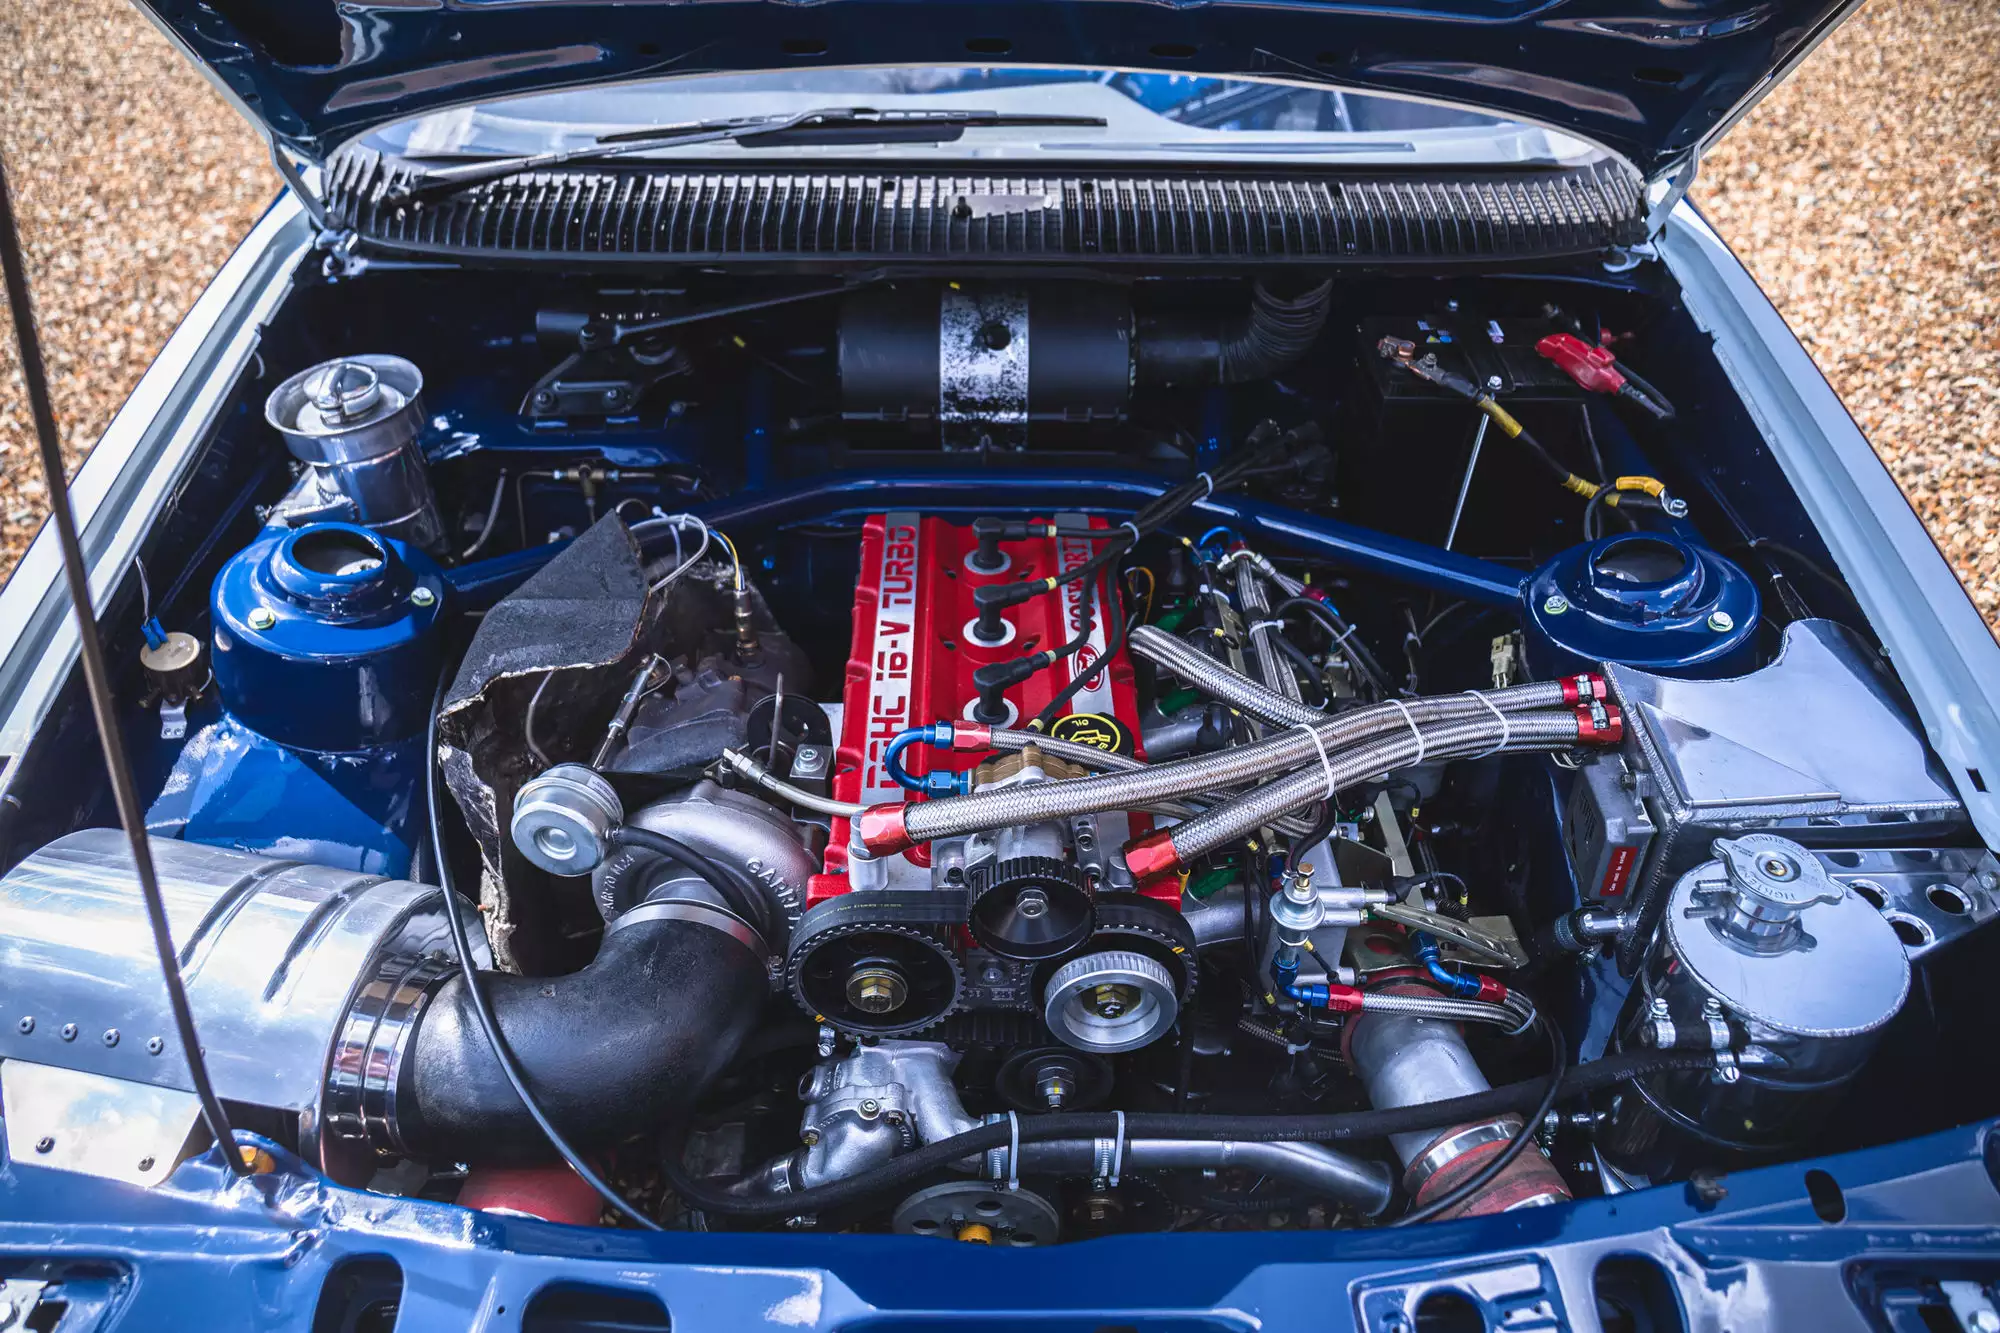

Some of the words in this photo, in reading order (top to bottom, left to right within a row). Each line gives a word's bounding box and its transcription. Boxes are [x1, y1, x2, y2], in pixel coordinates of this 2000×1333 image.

[882, 525, 916, 609] TURBO
[1063, 535, 1097, 632] COSWORT
[877, 620, 910, 682] 16-V
